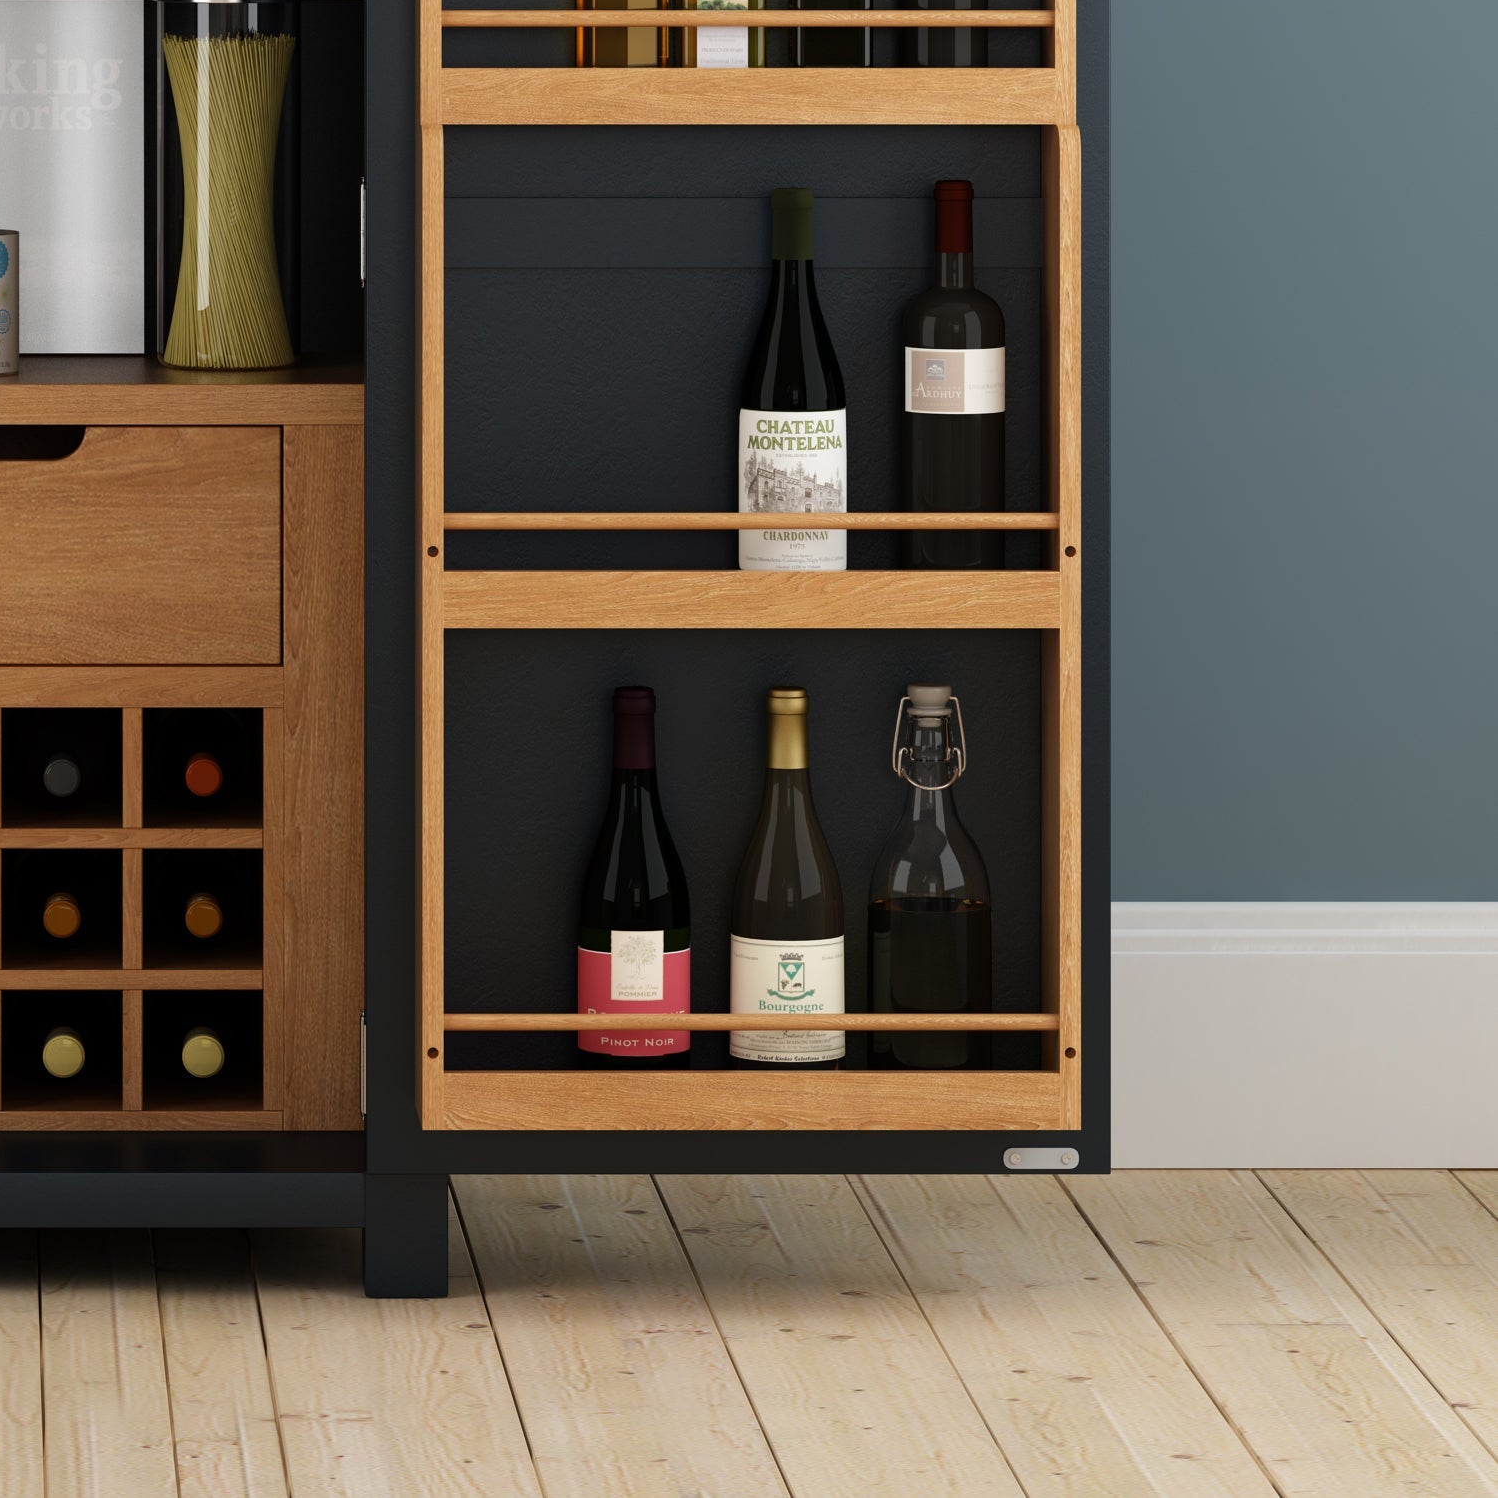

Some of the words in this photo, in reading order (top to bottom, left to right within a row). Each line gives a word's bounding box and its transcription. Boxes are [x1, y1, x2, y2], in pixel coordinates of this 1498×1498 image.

[756, 419, 835, 435] CHATEAU
[747, 435, 843, 451] MONTELENA
[763, 531, 830, 542] CHARDONNAY
[758, 999, 825, 1014] Bourgogne
[600, 1036, 640, 1047] PINOT
[644, 1037, 675, 1047] NOIR
